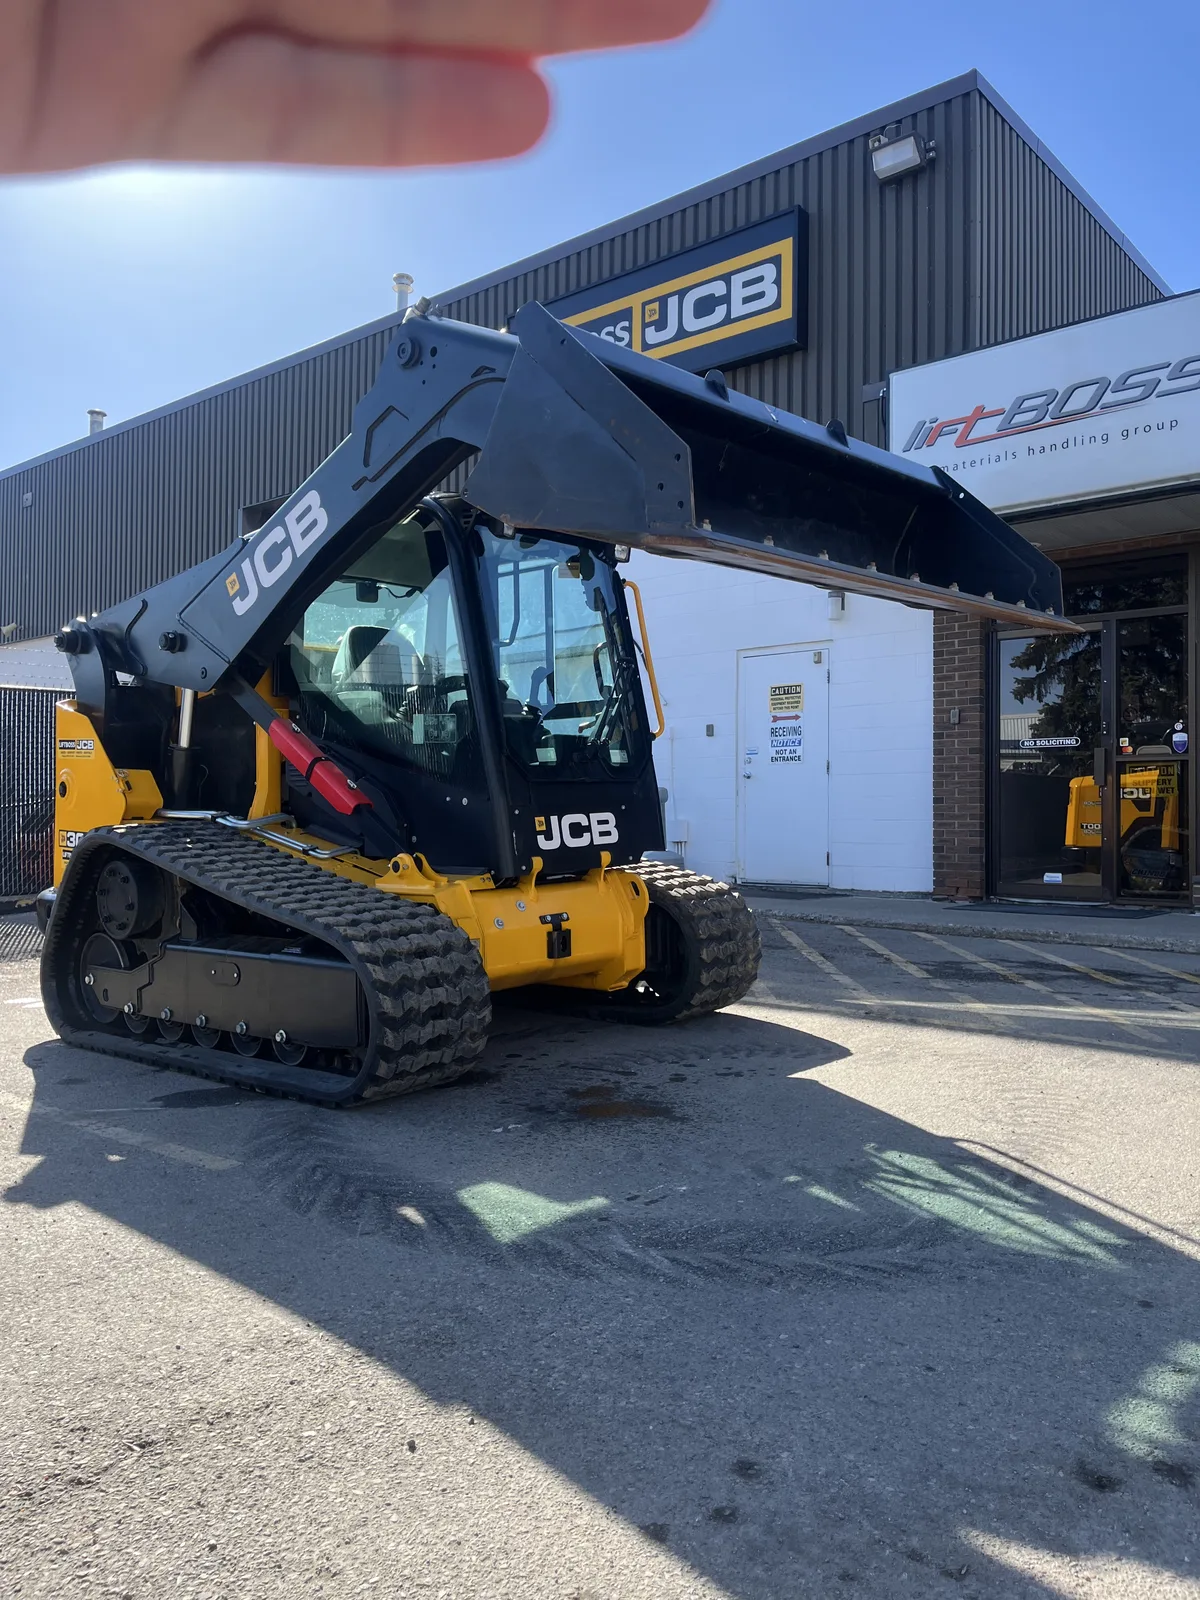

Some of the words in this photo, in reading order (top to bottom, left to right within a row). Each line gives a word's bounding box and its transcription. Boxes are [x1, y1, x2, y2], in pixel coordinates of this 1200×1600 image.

[644, 262, 778, 345] JCB
[589, 320, 630, 347] SS
[940, 451, 1017, 473] materials
[1027, 430, 1110, 457] handling
[1121, 417, 1179, 441] group
[231, 489, 328, 616] JCB
[771, 685, 801, 695] CAUTION
[770, 725, 802, 738] RECEIVING
[76, 740, 94, 749] JCB
[772, 738, 801, 747] NOTICE
[1036, 738, 1077, 746] SOLICITING
[771, 755, 802, 763] ENTRANCE
[536, 811, 619, 850] JCB
